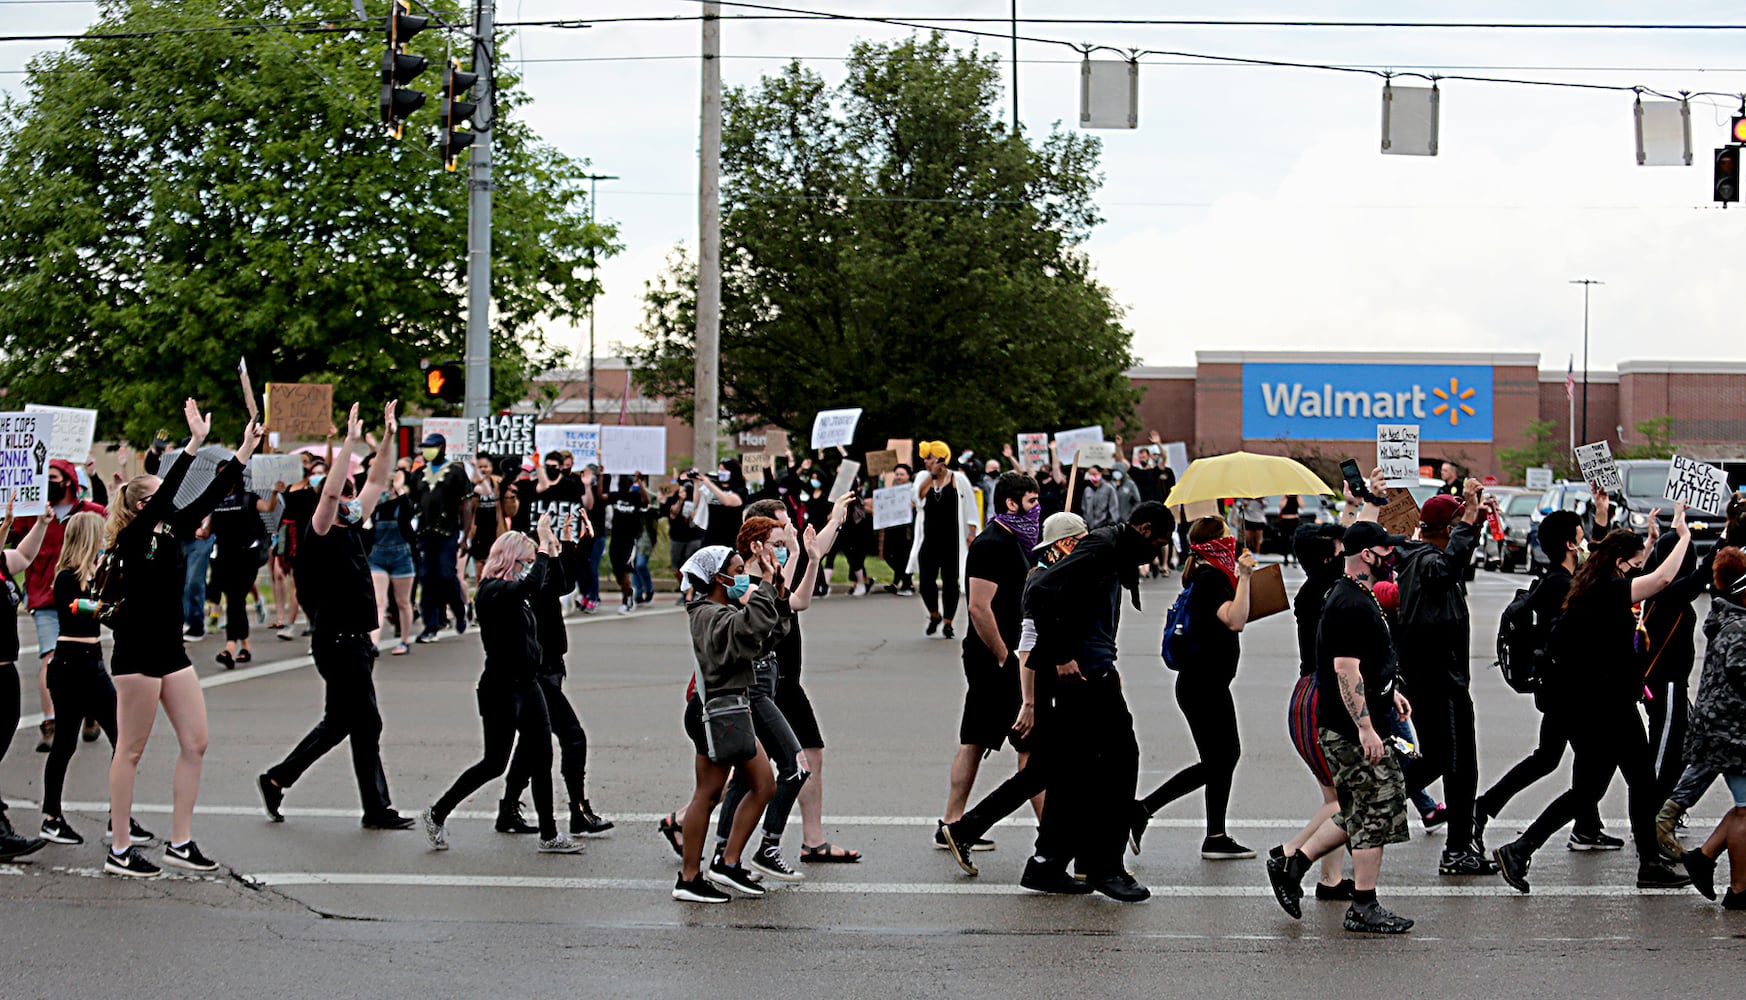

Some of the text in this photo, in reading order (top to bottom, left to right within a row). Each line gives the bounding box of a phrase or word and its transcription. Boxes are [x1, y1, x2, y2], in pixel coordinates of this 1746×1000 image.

[1262, 383, 1426, 418] Walmart
[14, 417, 36, 432] COPS
[479, 415, 533, 431] BLACK
[6, 433, 34, 449] KILLED
[482, 428, 531, 442] LIVES
[478, 441, 534, 455] MATTER
[565, 440, 597, 449] LIVES
[1674, 455, 1713, 479] BLACK
[1680, 471, 1720, 491] LIVES
[20, 486, 40, 502] FREE
[1665, 479, 1720, 514] MATTER
